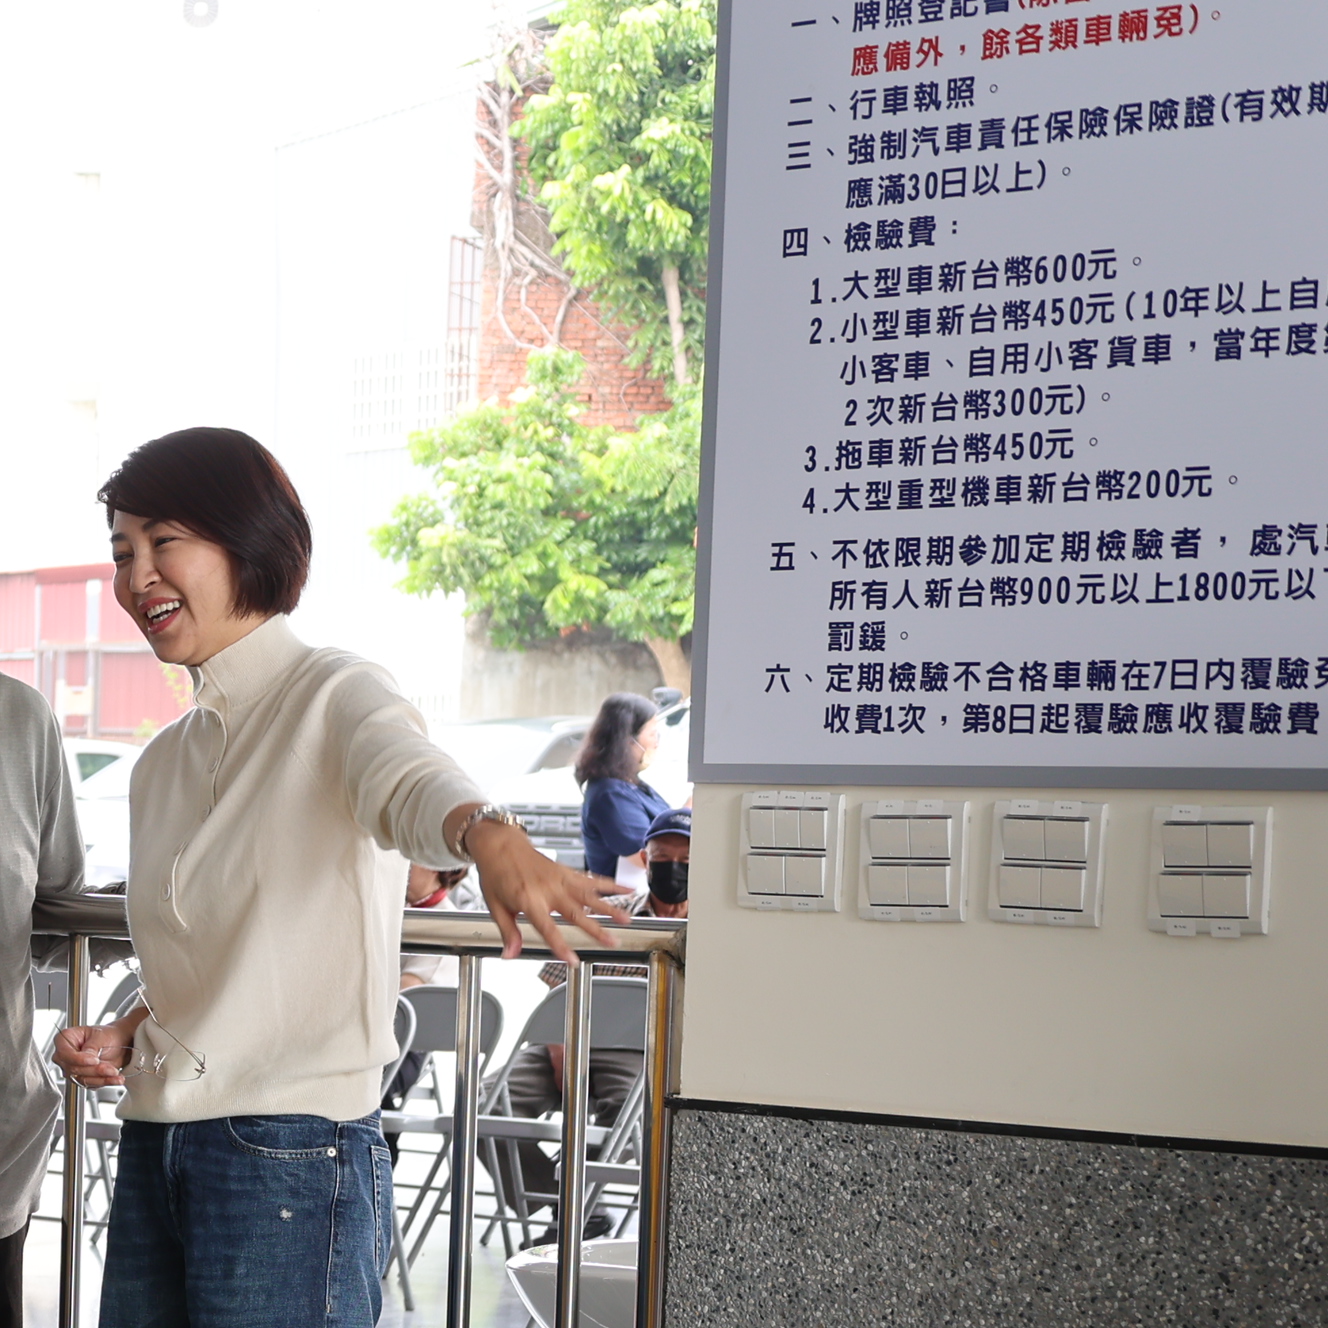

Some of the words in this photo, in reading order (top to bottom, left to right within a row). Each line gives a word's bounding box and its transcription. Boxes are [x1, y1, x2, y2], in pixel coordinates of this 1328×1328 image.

[808, 276, 1328, 345] 2.小型車新台幣450元(10年以上自
[839, 321, 1328, 386] 小客車、自用小客貨車，當年度
[769, 522, 1328, 573] 五、不依限期參加定期檢驗者，處汽
[828, 567, 1328, 613] 所有人新台幣900元以上1800元以
